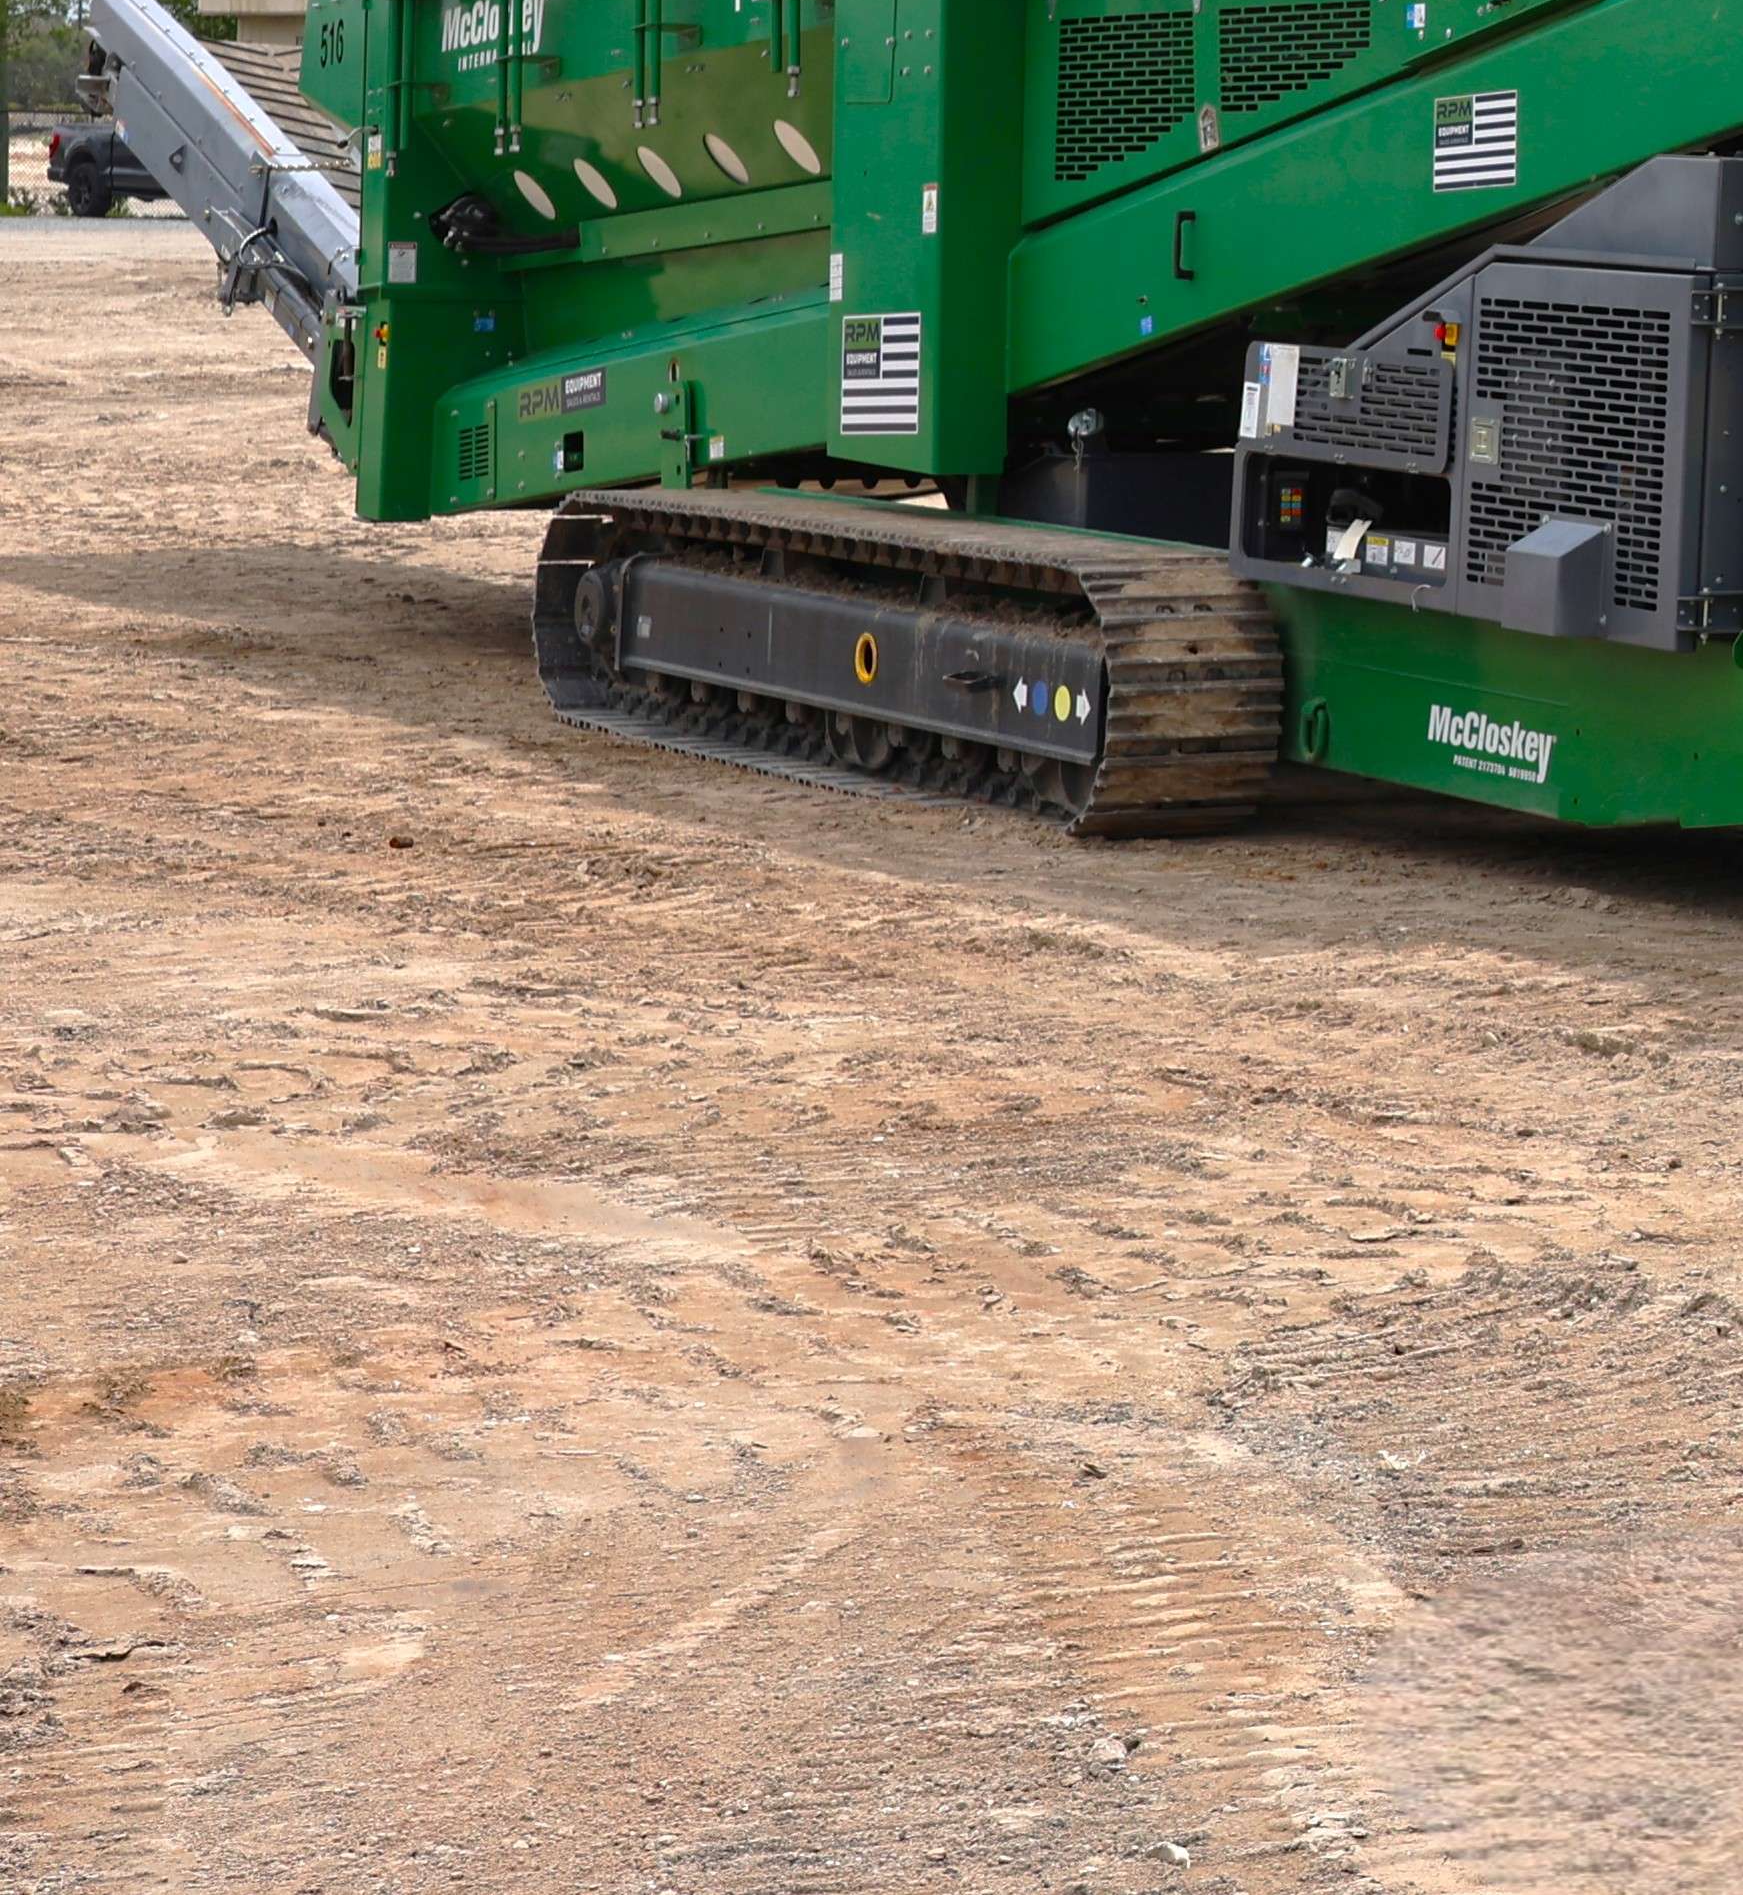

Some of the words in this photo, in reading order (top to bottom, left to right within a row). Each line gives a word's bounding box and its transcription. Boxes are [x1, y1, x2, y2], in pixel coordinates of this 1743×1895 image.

[320, 18, 345, 68] 516
[1437, 100, 1472, 119] RPM
[1438, 124, 1469, 137] EQUIPMENT
[845, 322, 880, 343] RPM
[564, 371, 602, 395] EQUIPMENT
[519, 384, 560, 418] RPM
[1427, 704, 1553, 784] McCloskey
